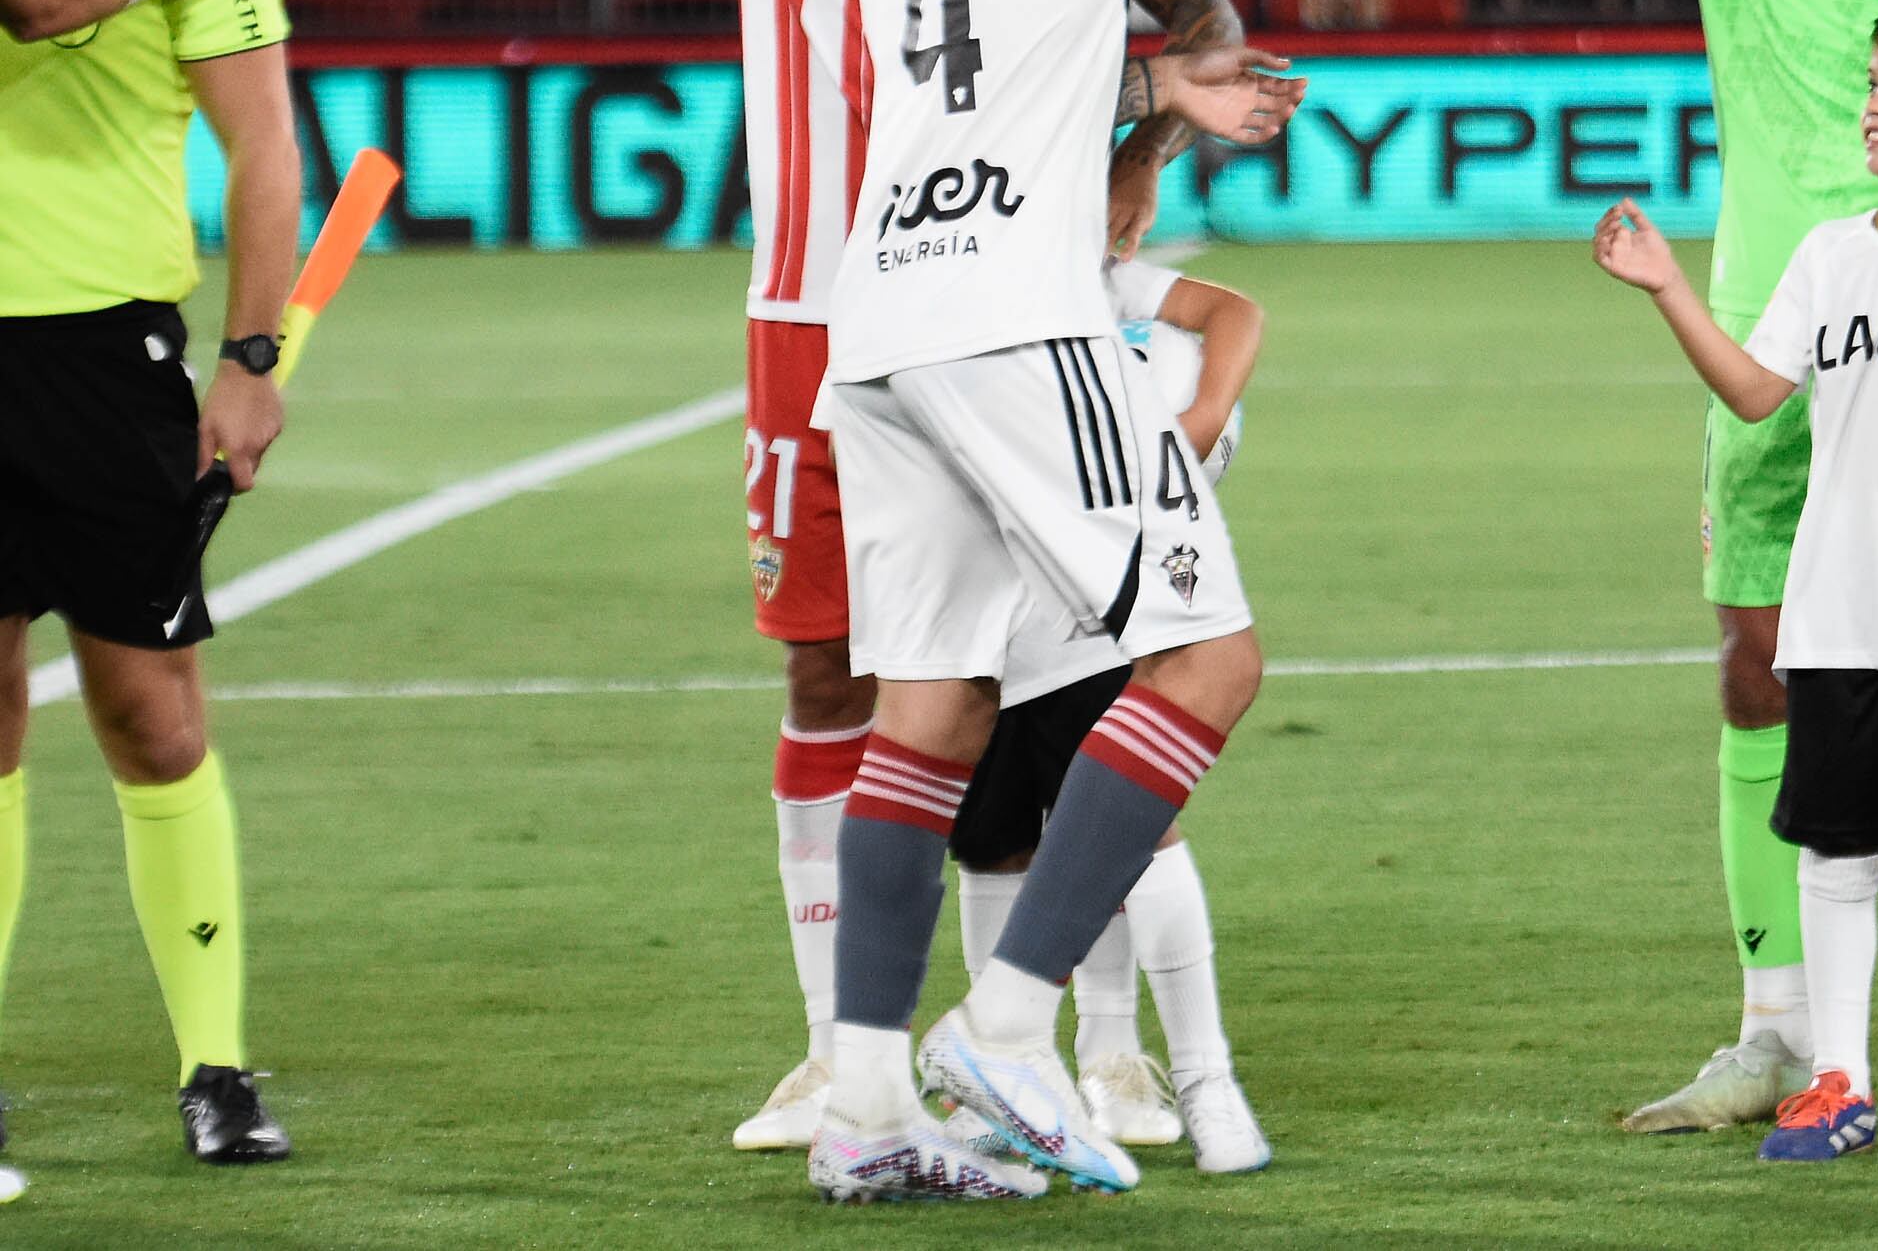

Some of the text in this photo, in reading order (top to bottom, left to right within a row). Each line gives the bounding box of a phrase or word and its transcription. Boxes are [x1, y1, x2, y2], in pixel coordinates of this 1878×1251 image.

[877, 230, 979, 272] ENERGÍA
[744, 427, 799, 539] 21
[1156, 430, 1200, 522] 4
